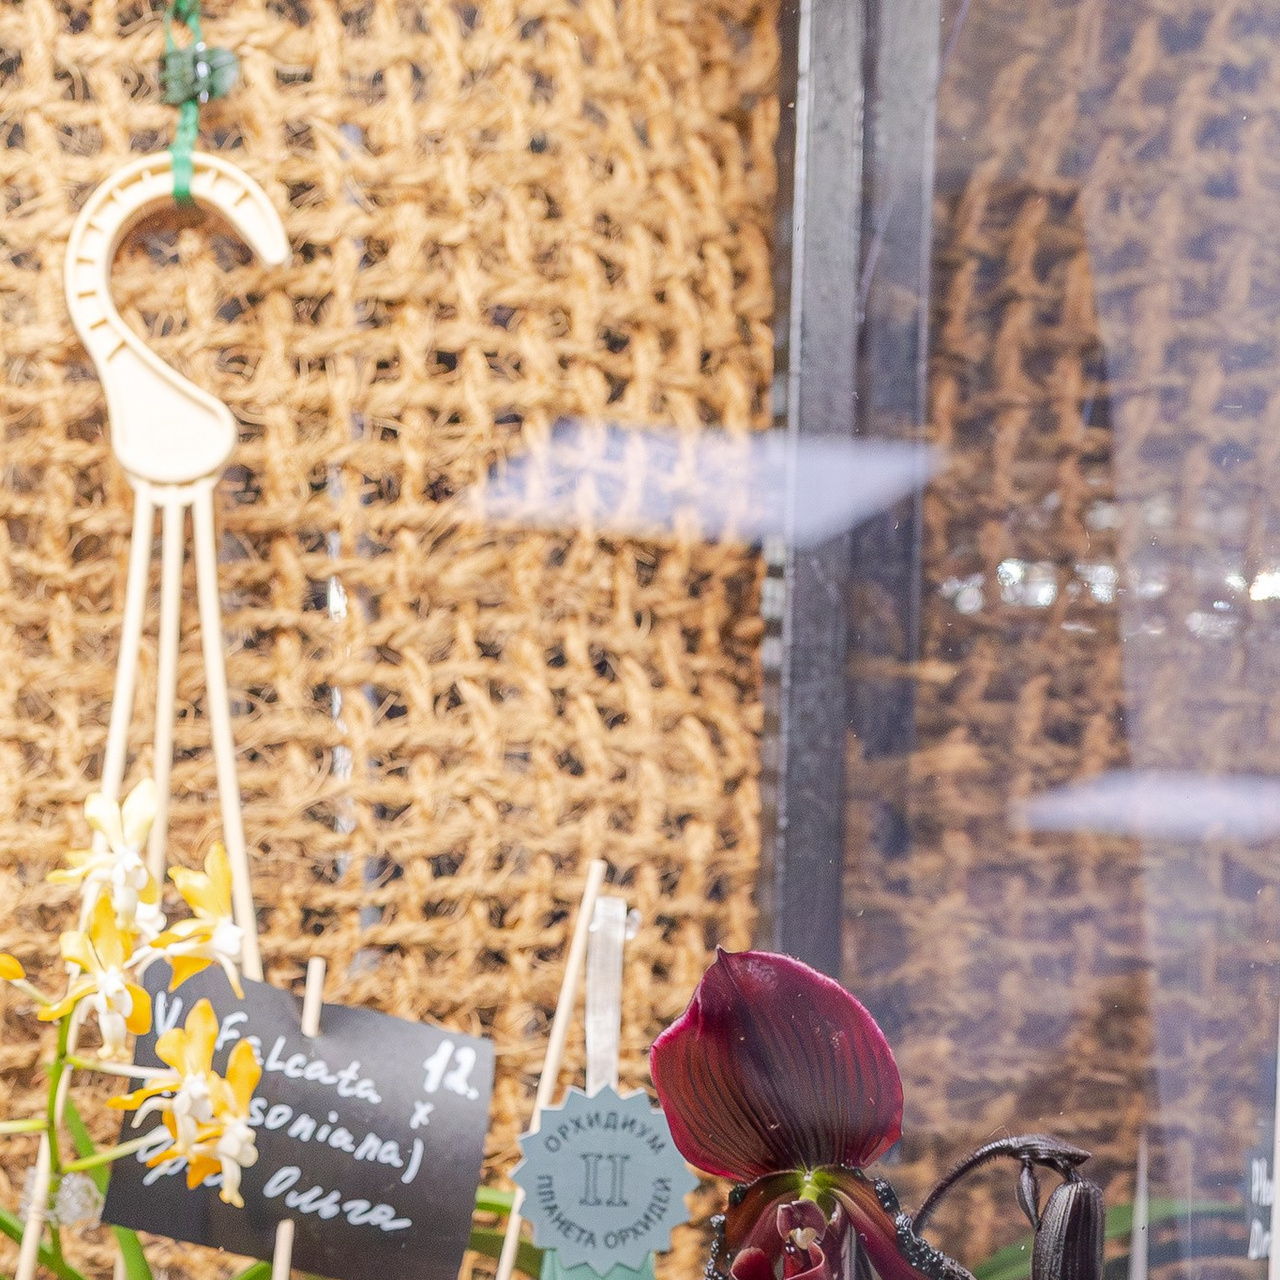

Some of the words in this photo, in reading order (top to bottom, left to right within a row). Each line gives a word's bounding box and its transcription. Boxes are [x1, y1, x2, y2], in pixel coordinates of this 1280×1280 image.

[544, 1111, 665, 1155] ОРХИДИУМ
[580, 1153, 629, 1207] II
[537, 1174, 596, 1248] ПЛАНЕТА
[603, 1177, 671, 1249] ОРХИДЕЙ
